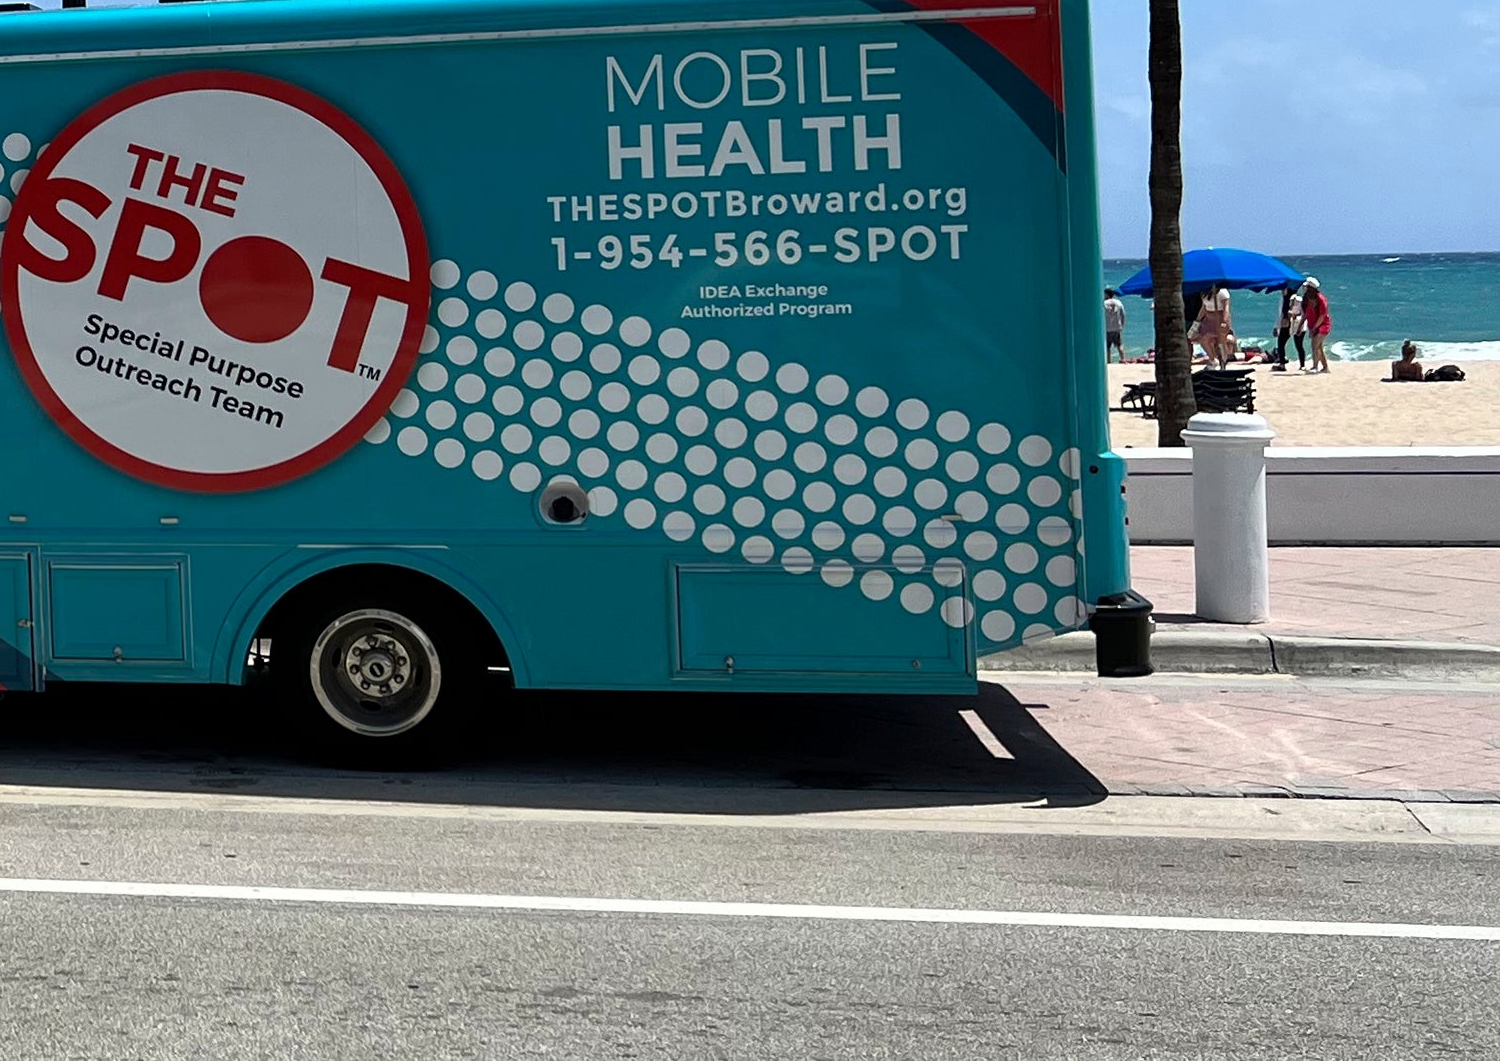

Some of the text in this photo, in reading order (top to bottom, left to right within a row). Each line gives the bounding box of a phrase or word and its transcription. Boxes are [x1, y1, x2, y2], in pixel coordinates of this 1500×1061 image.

[606, 42, 901, 113] MOBILE
[126, 143, 246, 218] THE
[607, 113, 902, 180] HEALTH
[547, 183, 967, 222] THESPOTBroward.org
[17, 177, 411, 374] SPOT
[551, 224, 968, 271] 1-954-566-SPOT
[680, 302, 853, 318] Authorized Program
[699, 283, 828, 299] IDEA Exchange
[75, 346, 285, 429] Outreach Team
[83, 313, 304, 399] Special Purpose
